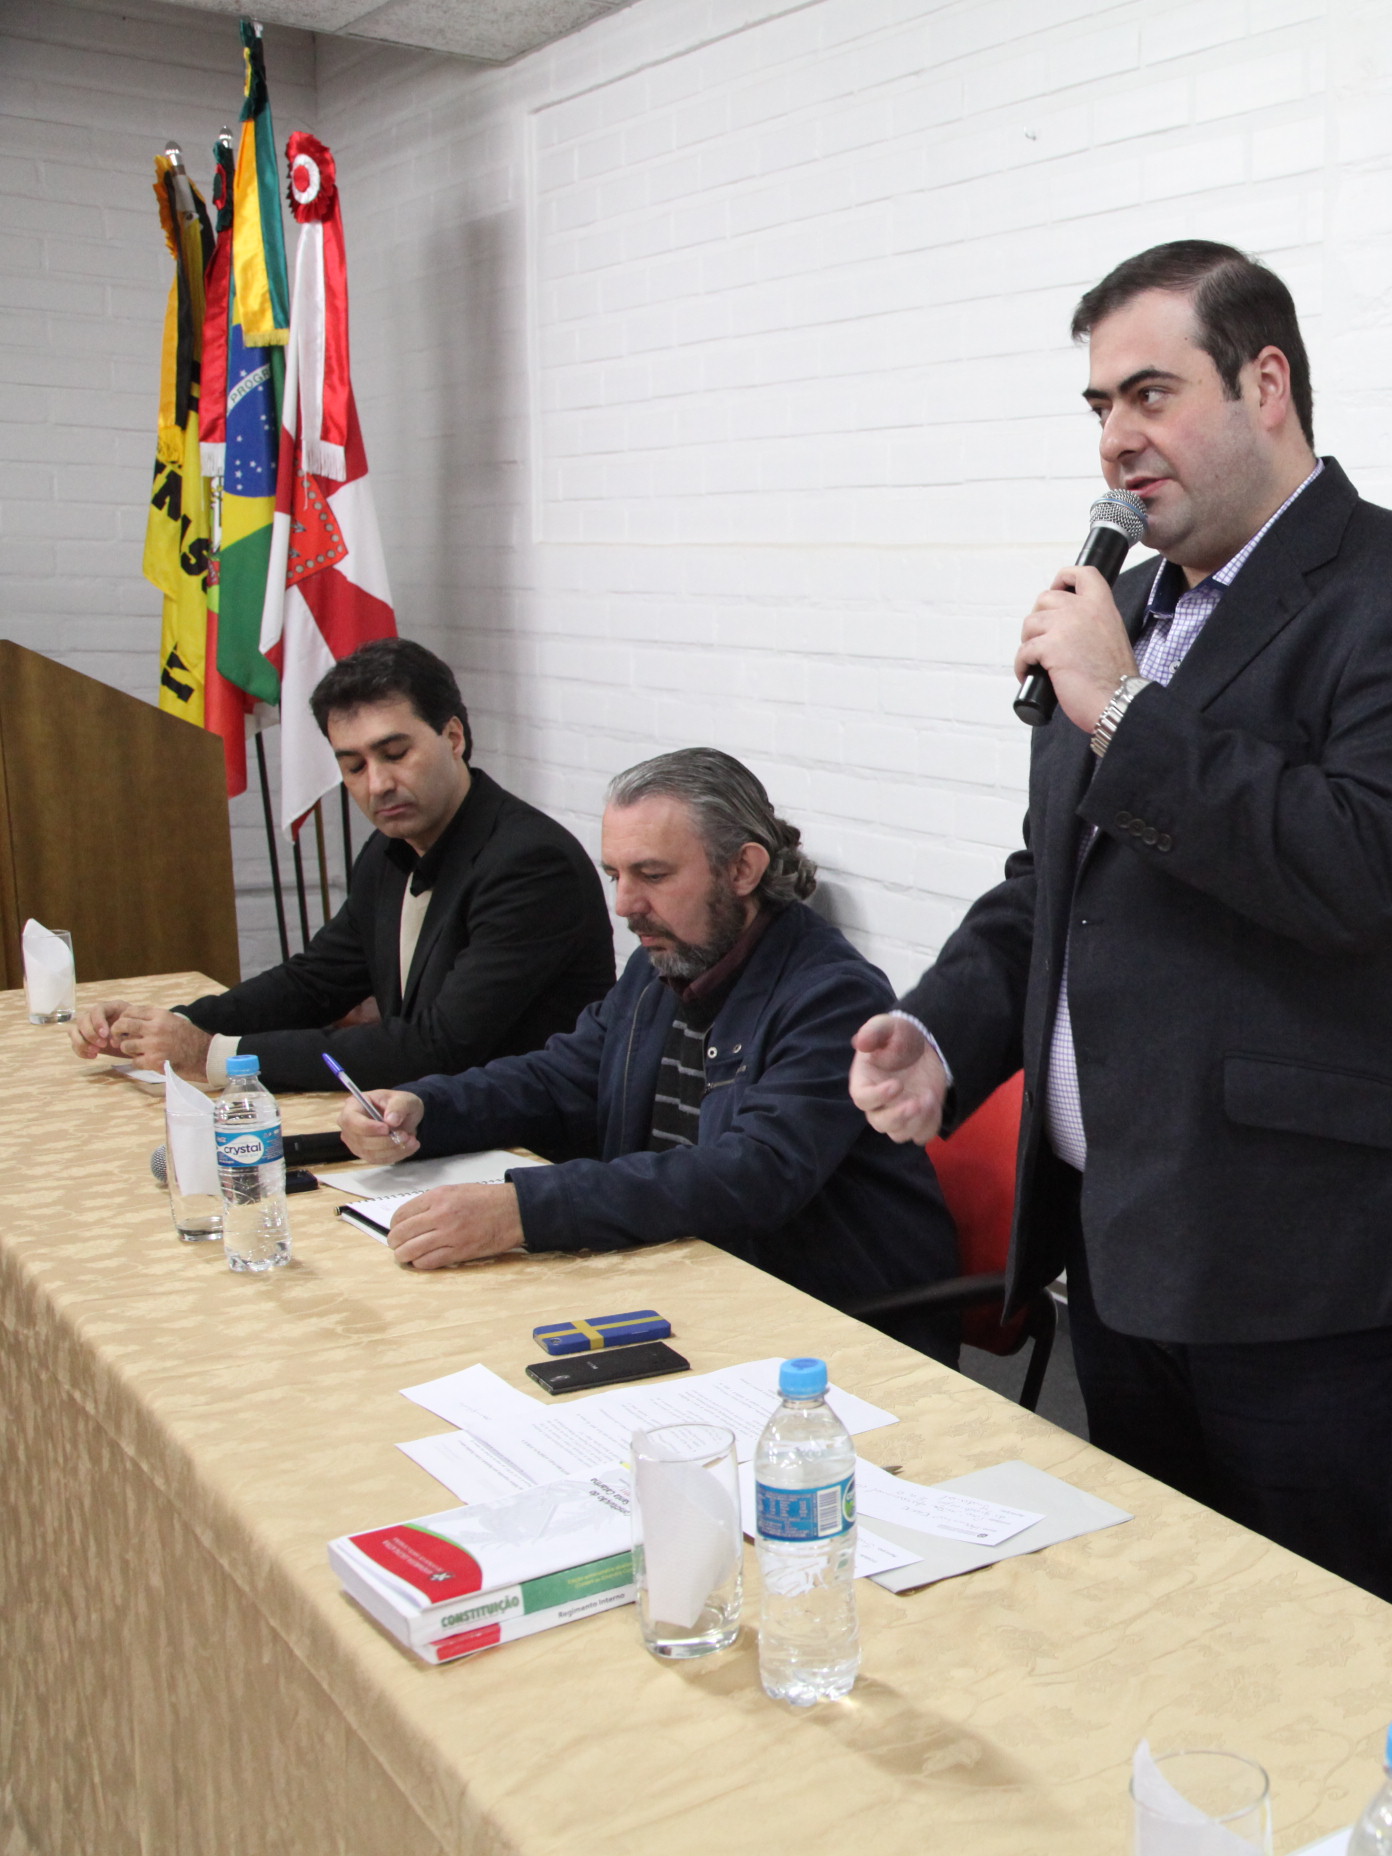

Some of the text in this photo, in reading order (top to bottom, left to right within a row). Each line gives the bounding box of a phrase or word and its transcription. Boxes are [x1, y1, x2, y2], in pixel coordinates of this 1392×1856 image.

[223, 1142, 262, 1155] crystal
[440, 1595, 520, 1629] CONSTITUIÇÃO
[558, 1592, 626, 1619] Regimento Interno
